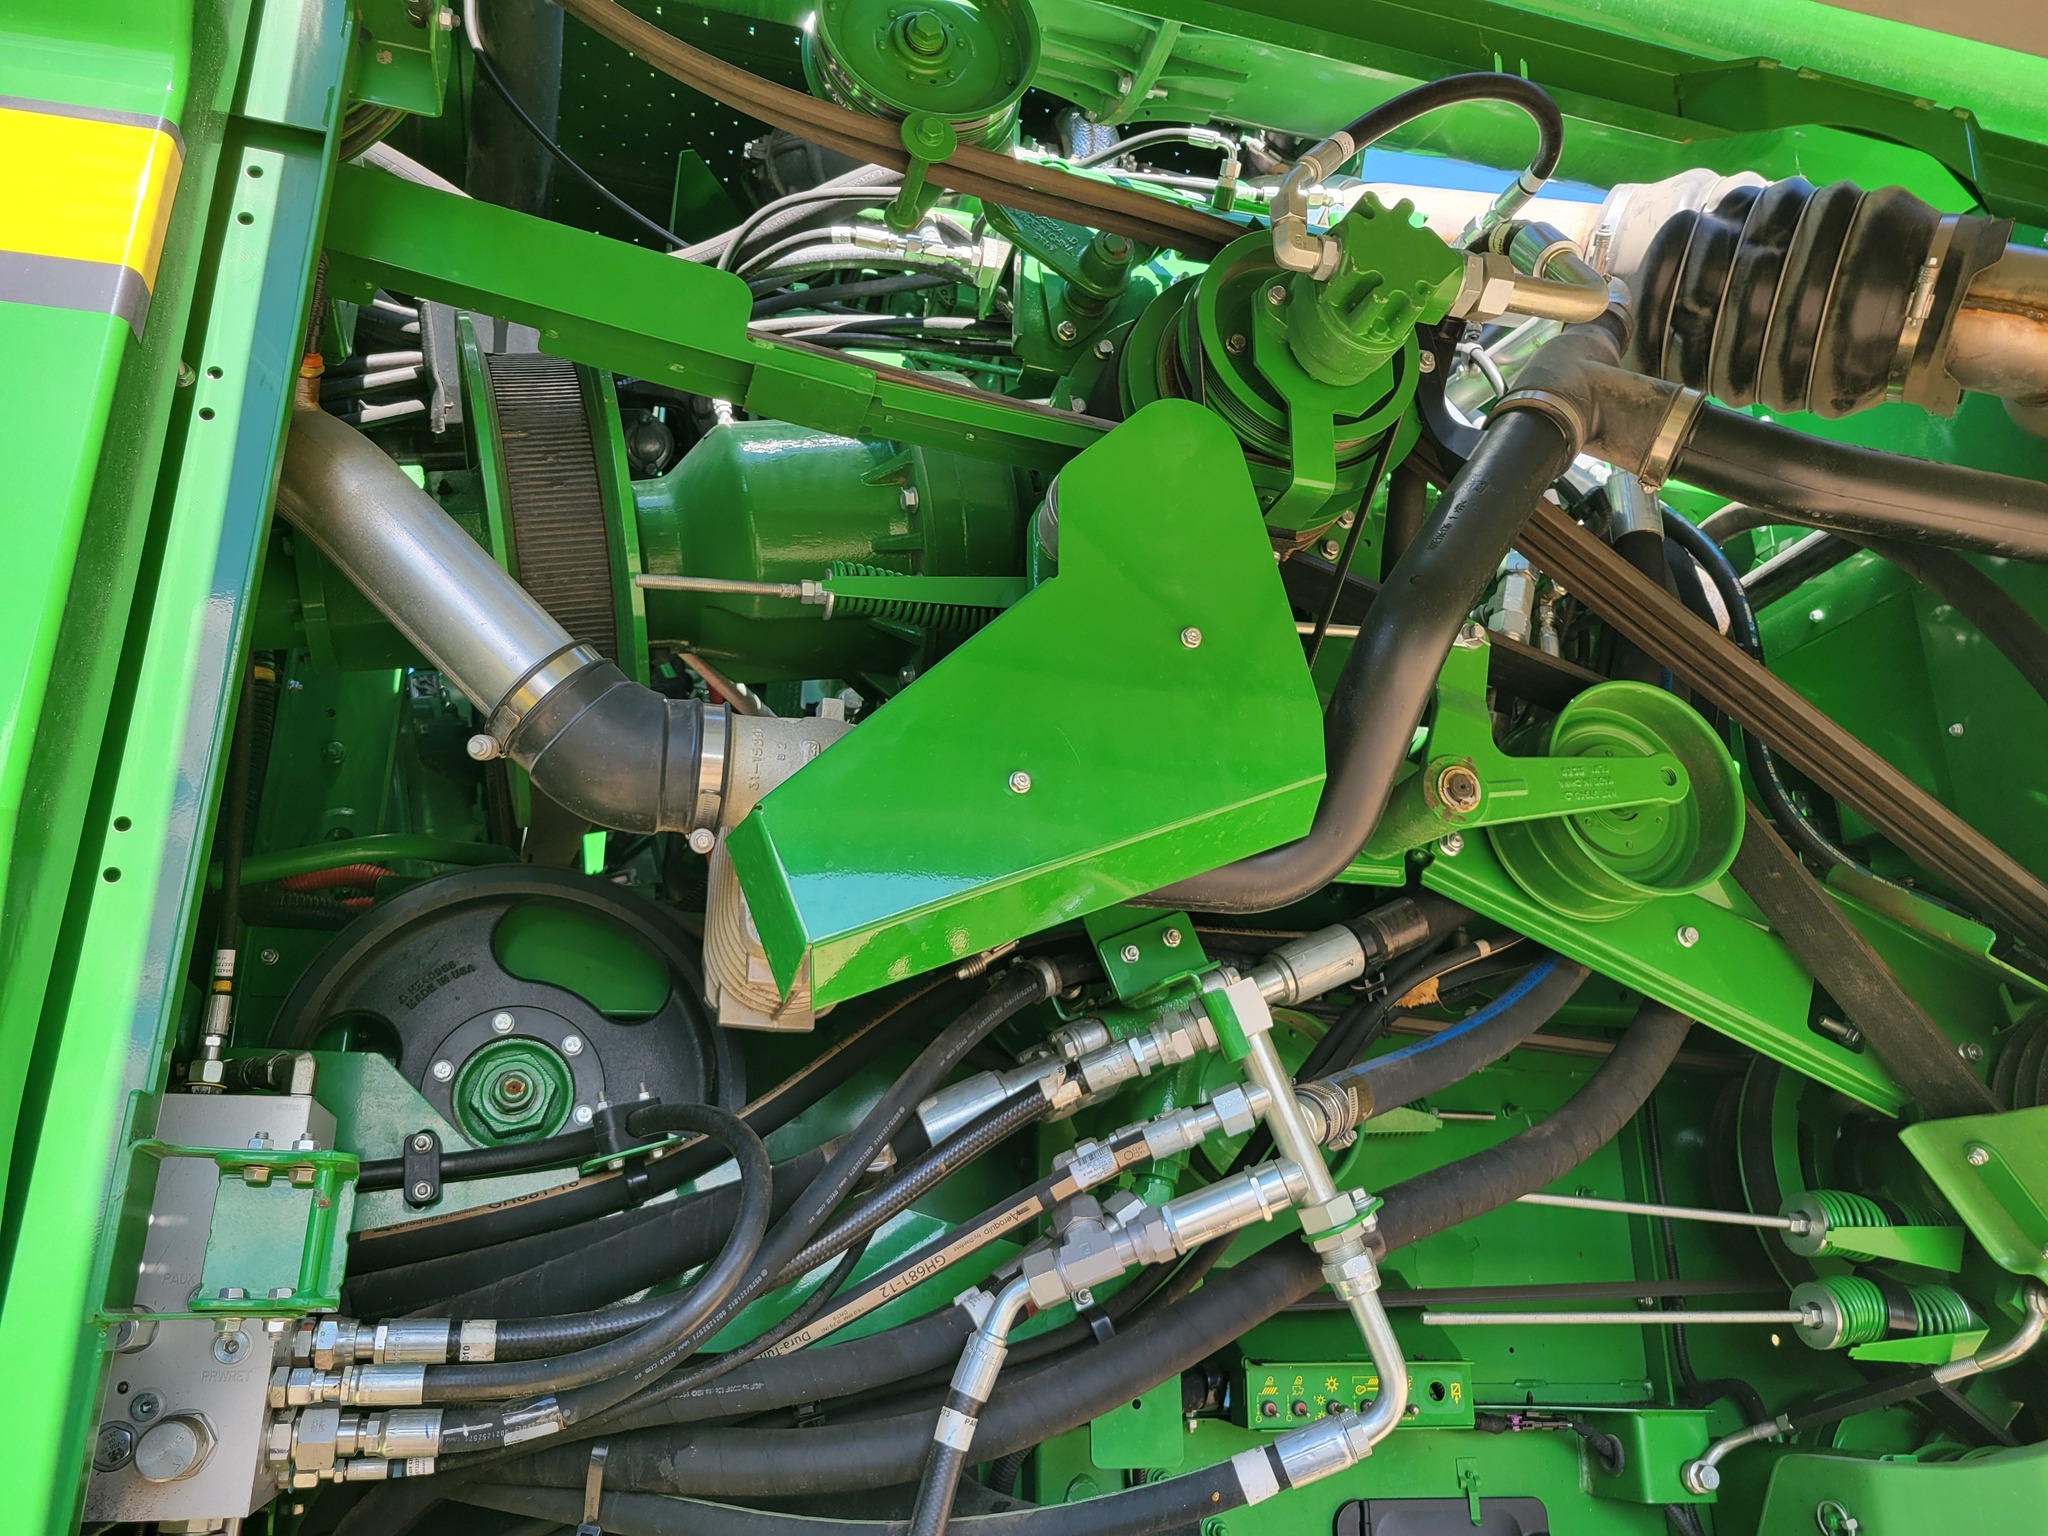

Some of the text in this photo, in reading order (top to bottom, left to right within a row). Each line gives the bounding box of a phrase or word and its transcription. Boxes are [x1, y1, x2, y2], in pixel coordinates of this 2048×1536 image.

[405, 962, 477, 1010] MADE IN USA
[981, 1209, 1021, 1237] Aeroquip
[951, 1236, 975, 1252] Danfoss
[972, 1231, 982, 1240] by
[161, 1272, 195, 1285] PAUX
[877, 1252, 947, 1299] GH681-12
[726, 1274, 763, 1310] 0575/221012
[691, 1308, 728, 1341] 0021252571
[831, 1308, 848, 1321] DN19
[201, 1370, 252, 1382] PRWRET
